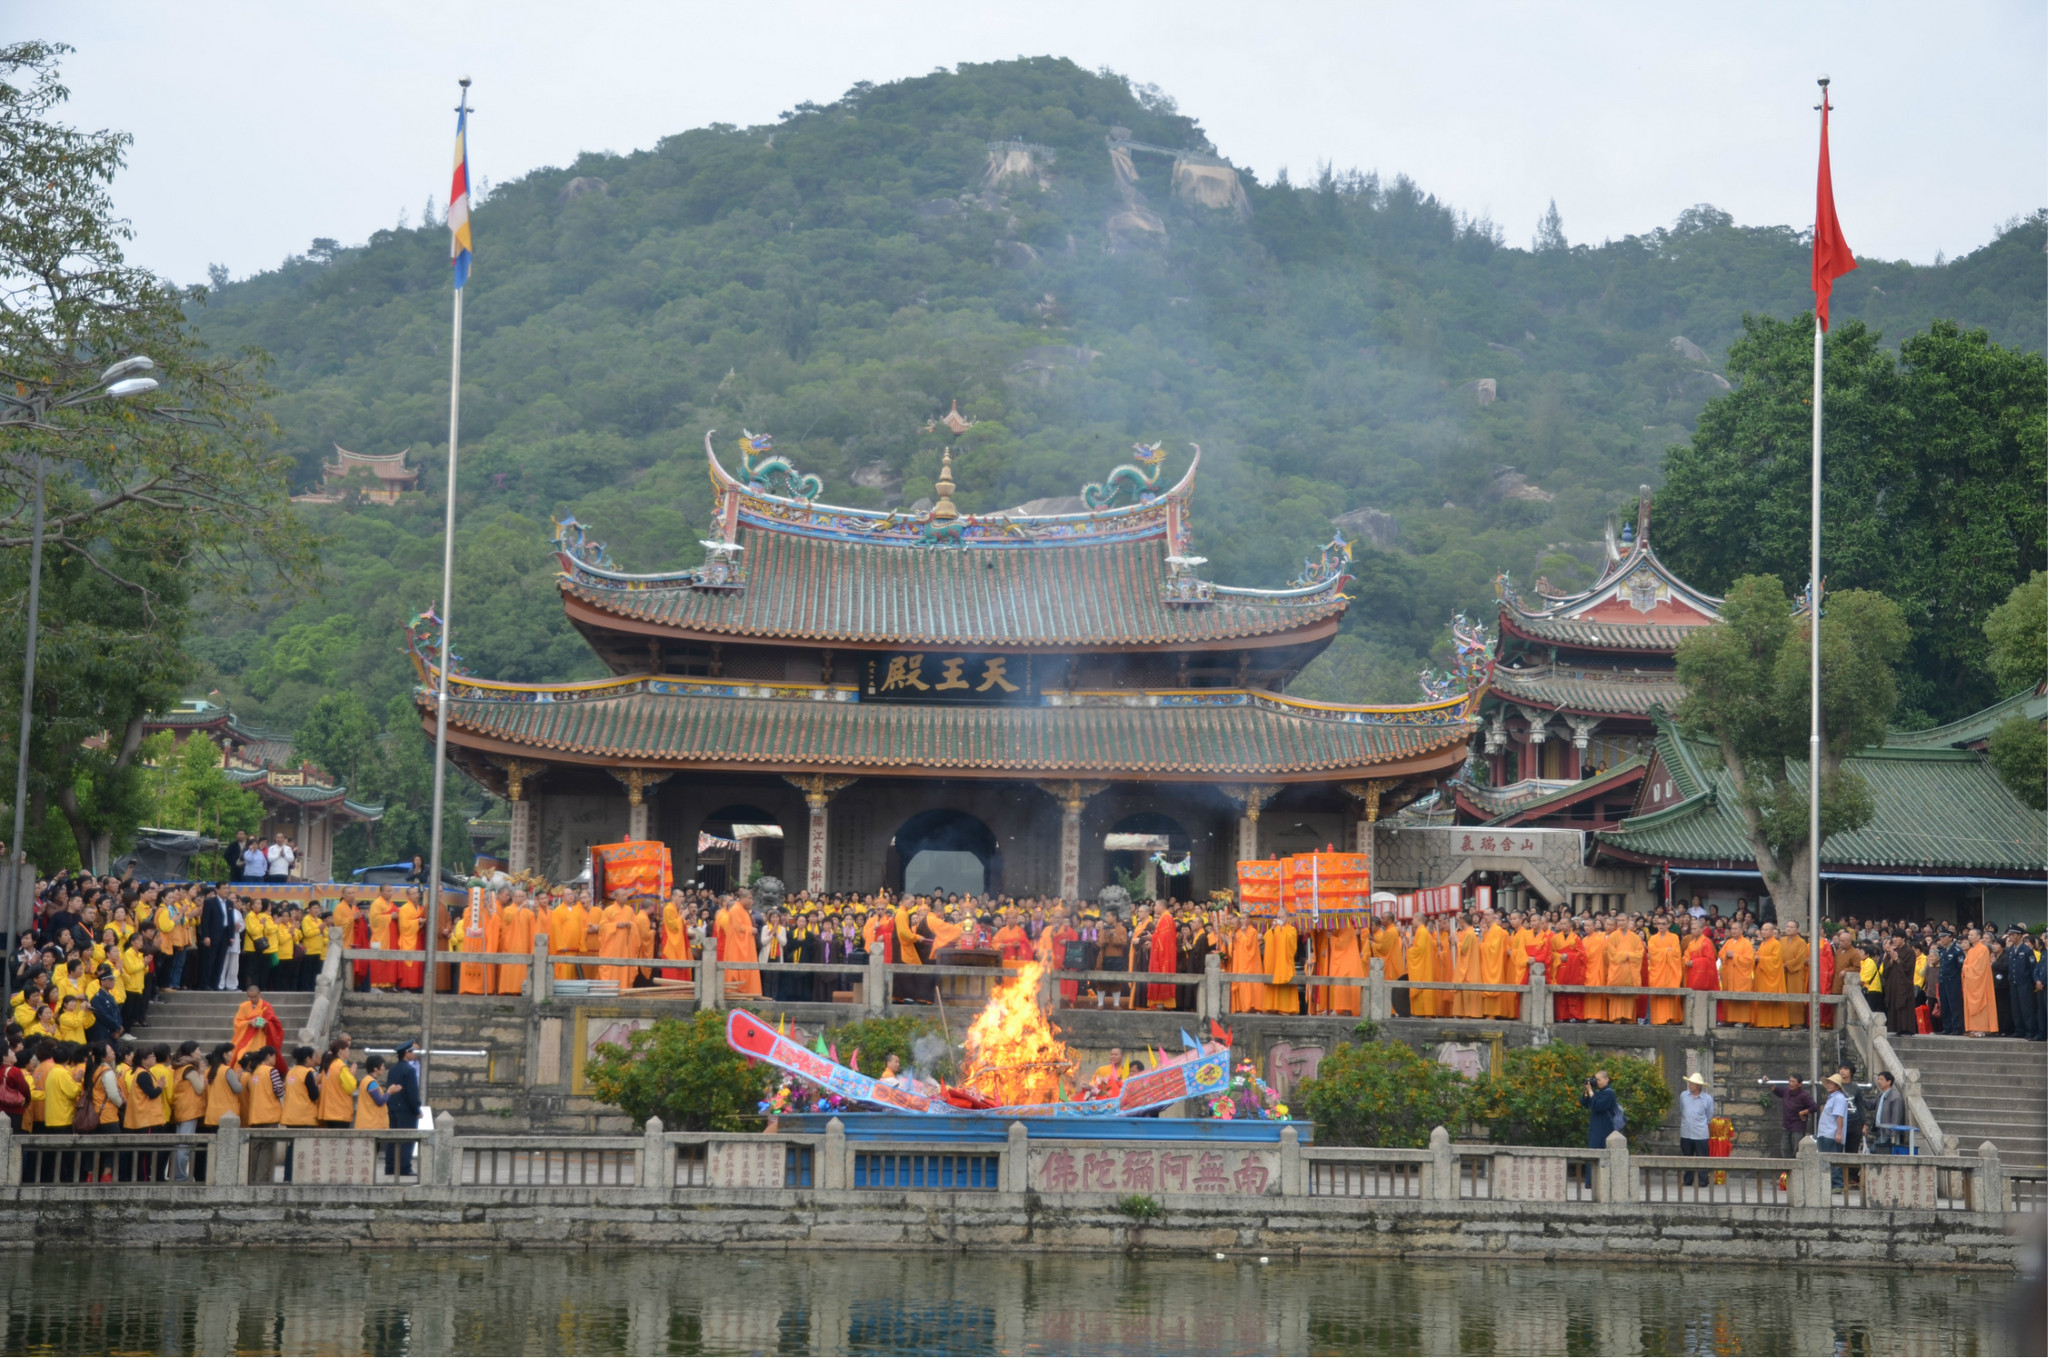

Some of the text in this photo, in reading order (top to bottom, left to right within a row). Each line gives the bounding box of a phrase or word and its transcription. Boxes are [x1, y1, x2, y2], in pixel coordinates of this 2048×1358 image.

[881, 654, 1020, 692] 天王殿
[1039, 1149, 1270, 1193] 南無阿彌陀佛
